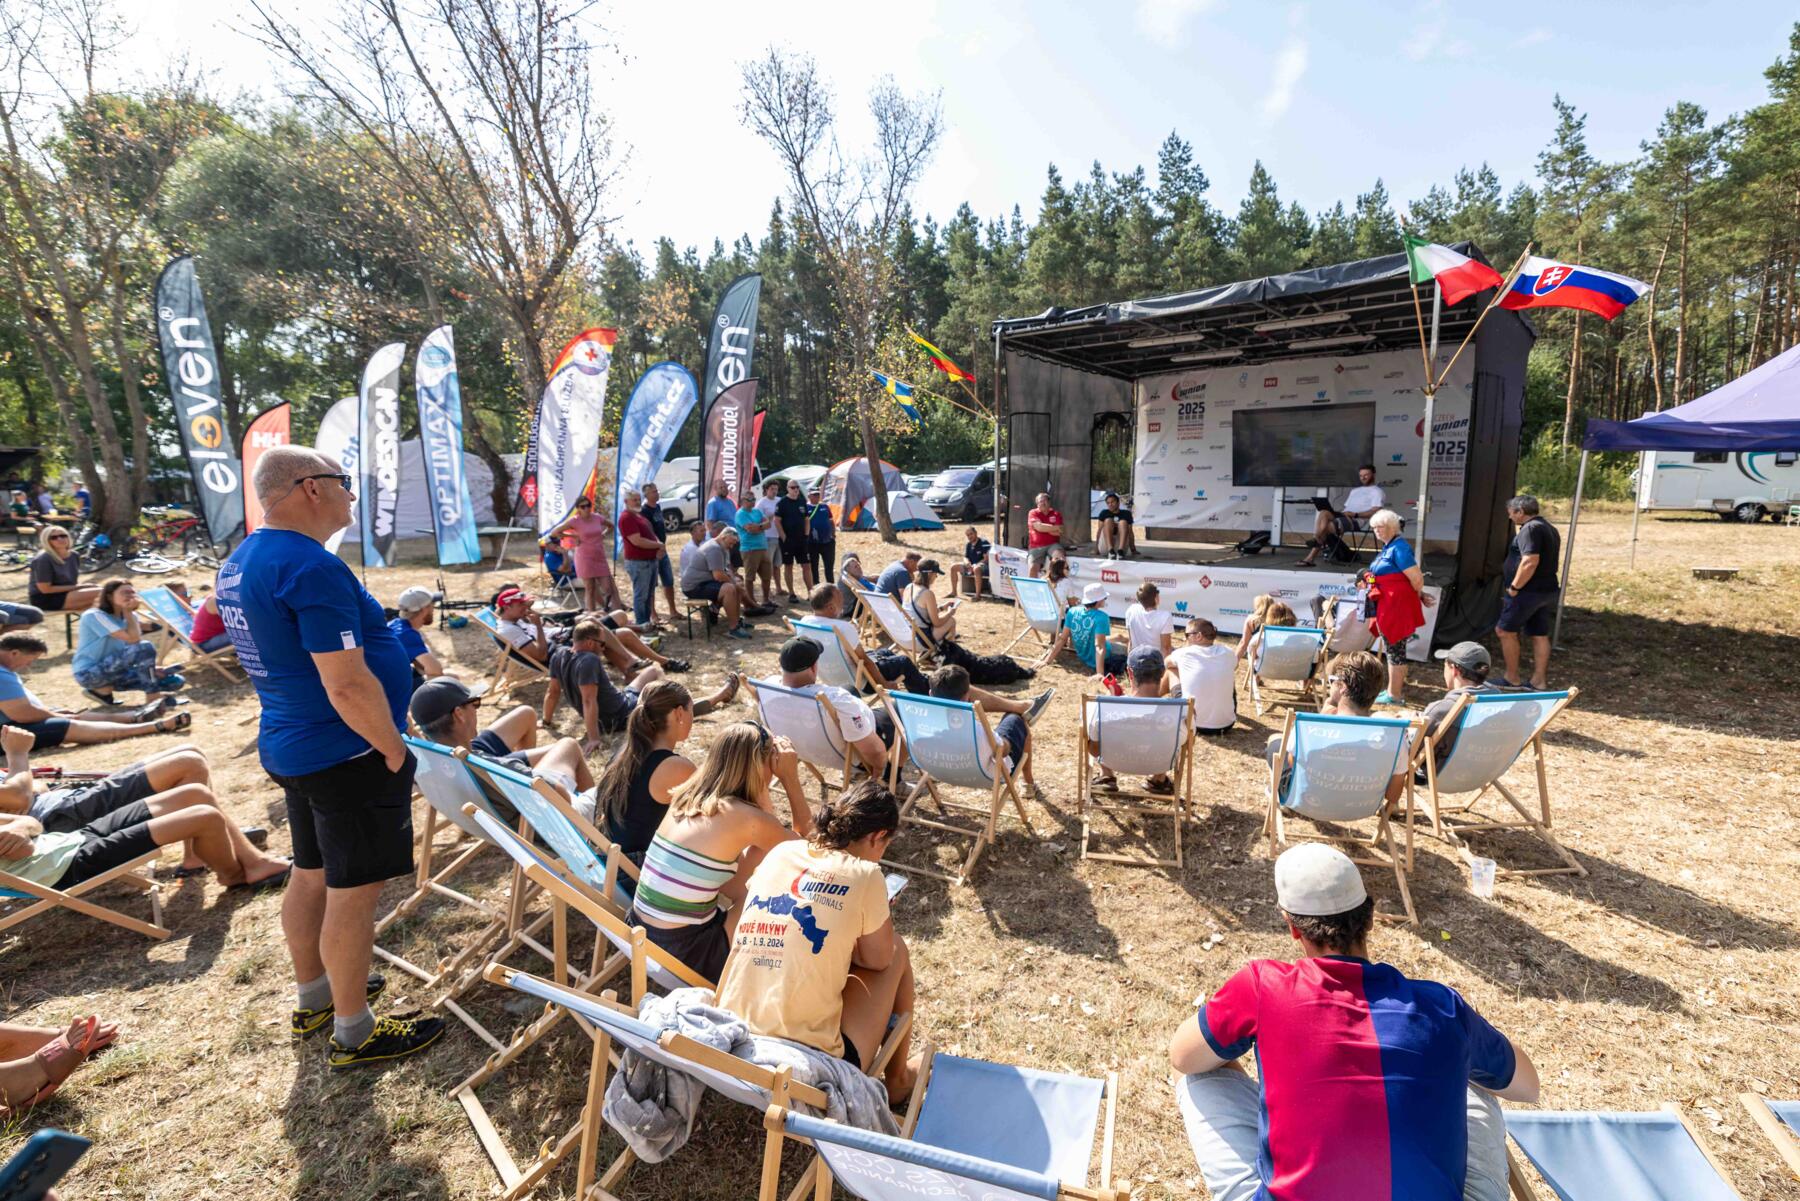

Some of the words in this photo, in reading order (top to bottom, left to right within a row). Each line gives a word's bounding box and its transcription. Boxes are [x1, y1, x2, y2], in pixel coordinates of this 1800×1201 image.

[1178, 402, 1205, 415] 2025
[1432, 419, 1468, 432] UNIOR
[252, 432, 282, 448] HH
[1430, 441, 1466, 455] 2025
[374, 387, 398, 538] WINDESIGN
[219, 604, 249, 631] 2025
[802, 882, 850, 896] JUNIOR
[808, 893, 844, 911] NATIONALS
[757, 920, 787, 936] MLÝNY
[767, 938, 784, 948] 2024
[753, 956, 782, 970] sailing.cz
